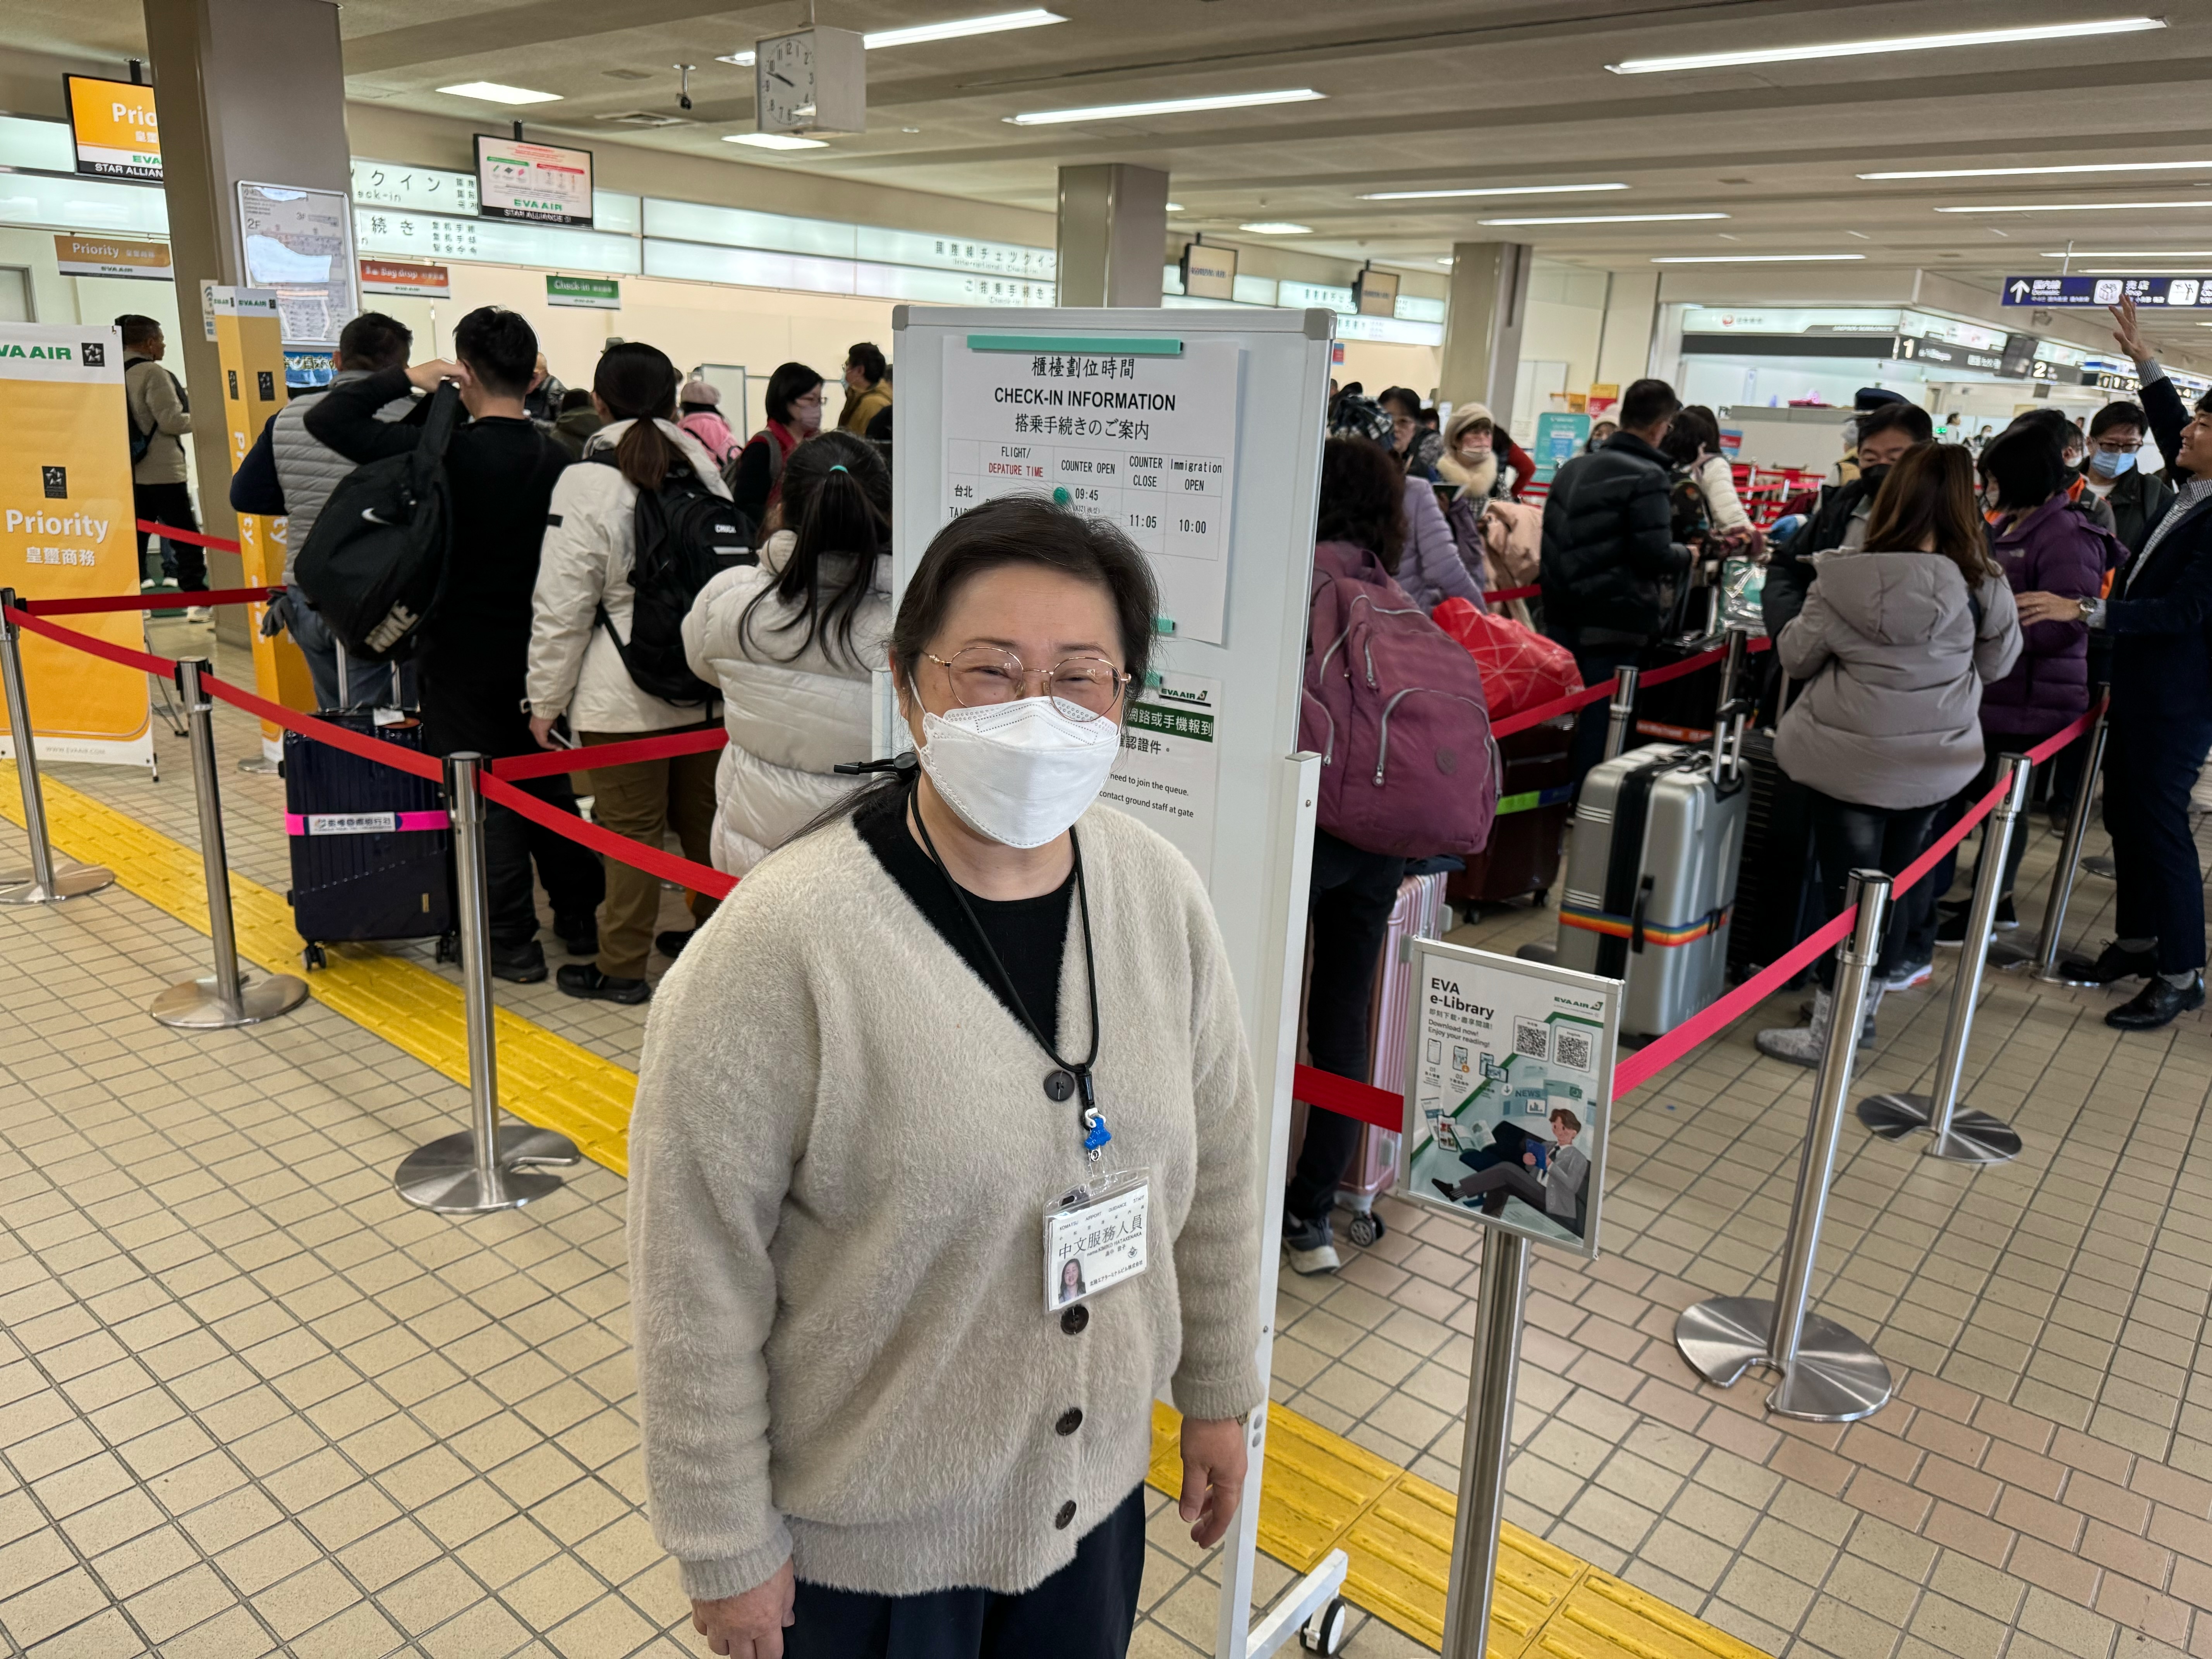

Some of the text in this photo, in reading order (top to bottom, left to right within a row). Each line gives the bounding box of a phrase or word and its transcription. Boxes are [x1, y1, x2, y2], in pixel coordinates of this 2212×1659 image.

[95, 163, 123, 174] STAR
[72, 243, 119, 258] Priority
[1903, 339, 1914, 359] 1
[1031, 356, 1135, 380] 櫃檯劃位時間
[2033, 361, 2047, 378] 2
[994, 387, 1176, 411] CHECK-IN INFORMATION
[1015, 413, 1149, 440] 搭乗手続きのご案内
[1001, 446, 1031, 459] FLIGHT/
[989, 462, 1044, 477] DEPATURE TIME
[1061, 459, 1115, 475] COUNTER OPEN
[1129, 455, 1163, 469] COUNTER
[1171, 458, 1222, 474] Immigration
[1133, 474, 1157, 488] CLOSE
[1185, 479, 1204, 491] OPEN
[954, 484, 973, 498] 台北
[1075, 488, 1099, 501] 09:45
[6, 509, 109, 544] Priority
[1130, 514, 1157, 529] 11:05
[1179, 519, 1206, 534] 10:00
[26, 546, 96, 567] 皇璽商務
[1110, 773, 1189, 796] need to join the queue.
[1099, 790, 1124, 802] contact
[1125, 796, 1150, 807] ground
[1152, 802, 1168, 812] staff
[1178, 809, 1194, 817] gate
[1431, 977, 1460, 995] EVA
[1430, 994, 1494, 1020] e-Library
[1428, 1018, 1479, 1037] Download now!
[1428, 1026, 1446, 1038] Enjoy
[1462, 1036, 1491, 1048] reading!
[1515, 1089, 1541, 1098] NEWS
[1060, 1221, 1079, 1231] KOMATSU
[1085, 1211, 1102, 1221] AIRPORT
[1059, 1214, 1142, 1260] 中文服務人員
